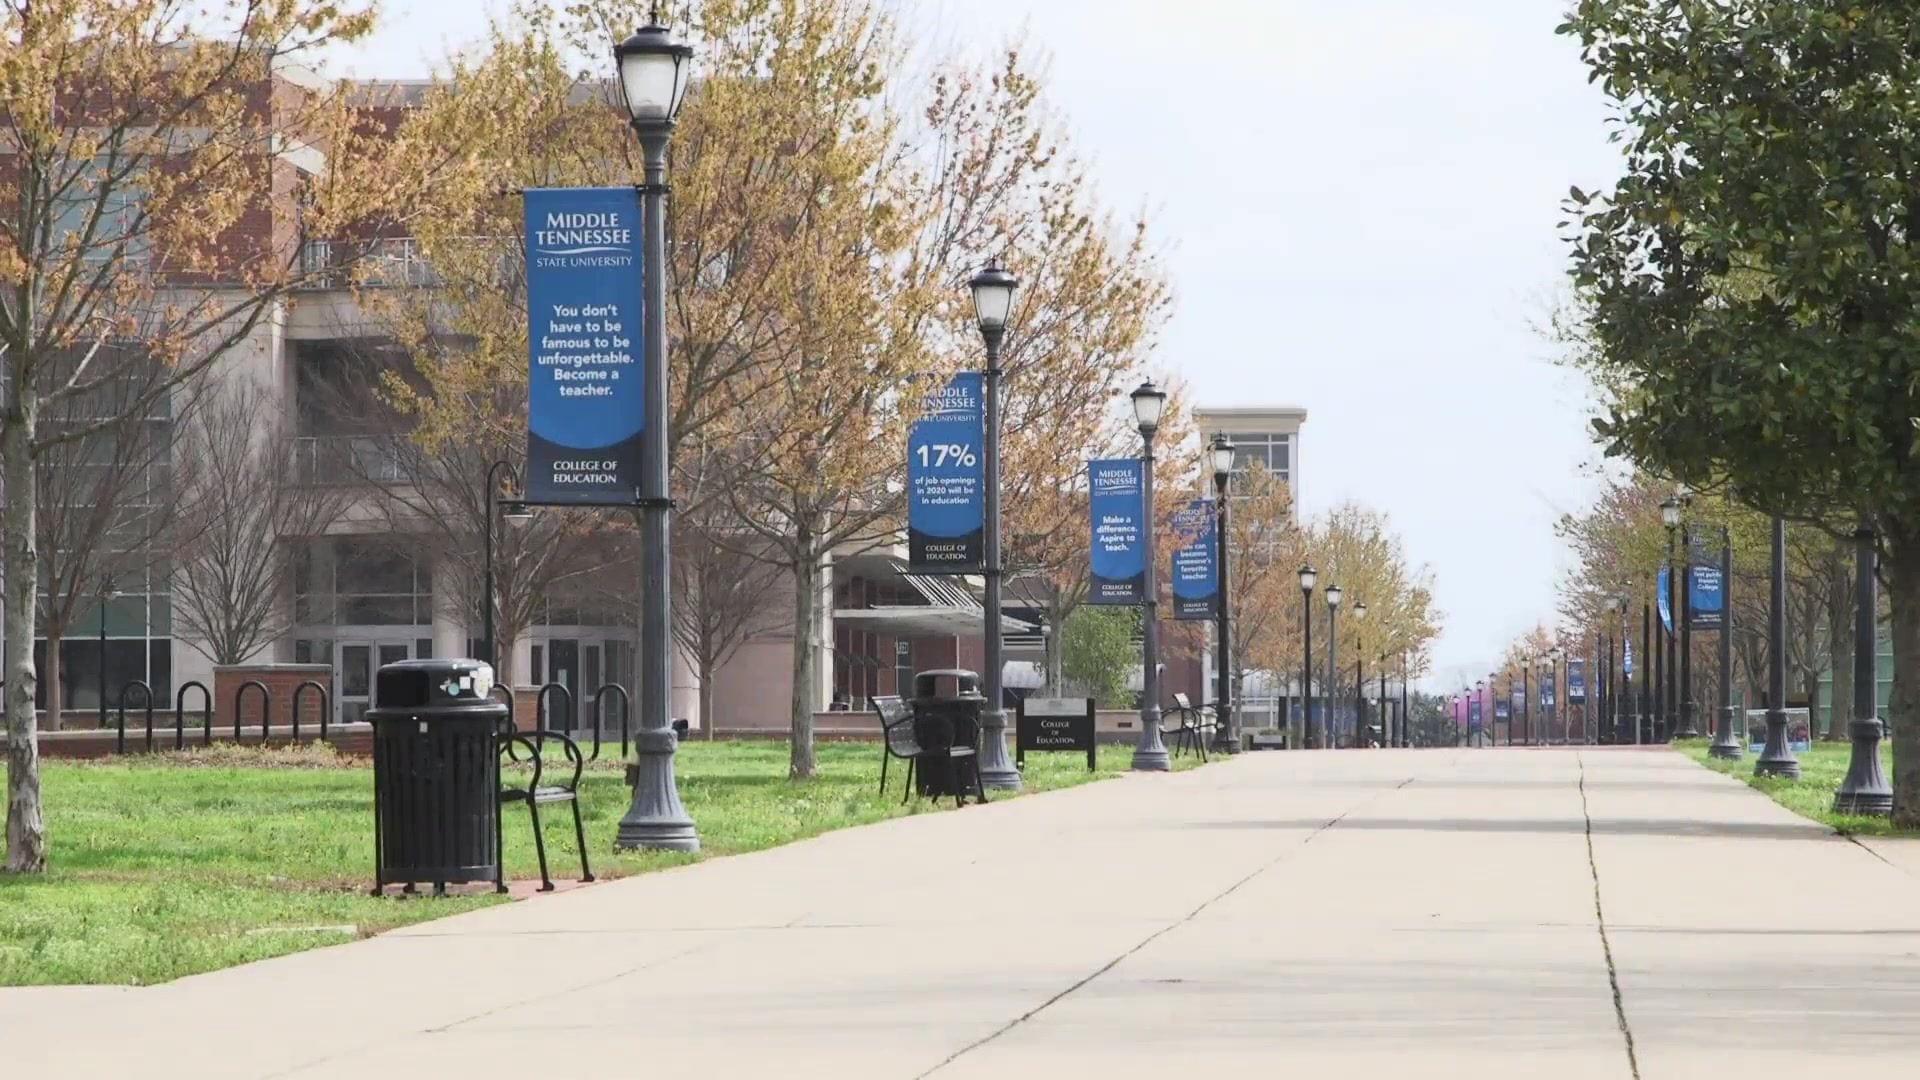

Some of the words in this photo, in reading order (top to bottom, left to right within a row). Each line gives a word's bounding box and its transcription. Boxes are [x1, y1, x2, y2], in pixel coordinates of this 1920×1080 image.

[547, 212, 618, 228] MIDDLE
[536, 229, 631, 245] TENNESSEE
[536, 258, 567, 267] STATE
[570, 256, 632, 267] UNIVERSITY
[553, 304, 578, 318] You
[582, 304, 618, 317] don't
[550, 320, 582, 333] have
[586, 321, 600, 333] to
[604, 320, 621, 333] be
[542, 336, 590, 349] famous
[594, 337, 608, 349] to
[613, 336, 630, 348] be
[538, 352, 634, 368] unforgettable.
[554, 368, 606, 381] Become
[611, 371, 619, 380] a
[560, 384, 613, 396] teacher.
[916, 444, 976, 468] 17%
[553, 460, 600, 472] COLLEGE
[602, 460, 618, 471] OF
[554, 473, 617, 484] EDUCATION
[1098, 469, 1132, 477] MIDDLE
[915, 476, 924, 484] of
[925, 476, 938, 486] job
[940, 476, 976, 486] openings
[1094, 477, 1137, 486] TENNESSEE
[1099, 535, 1124, 543] Aspire
